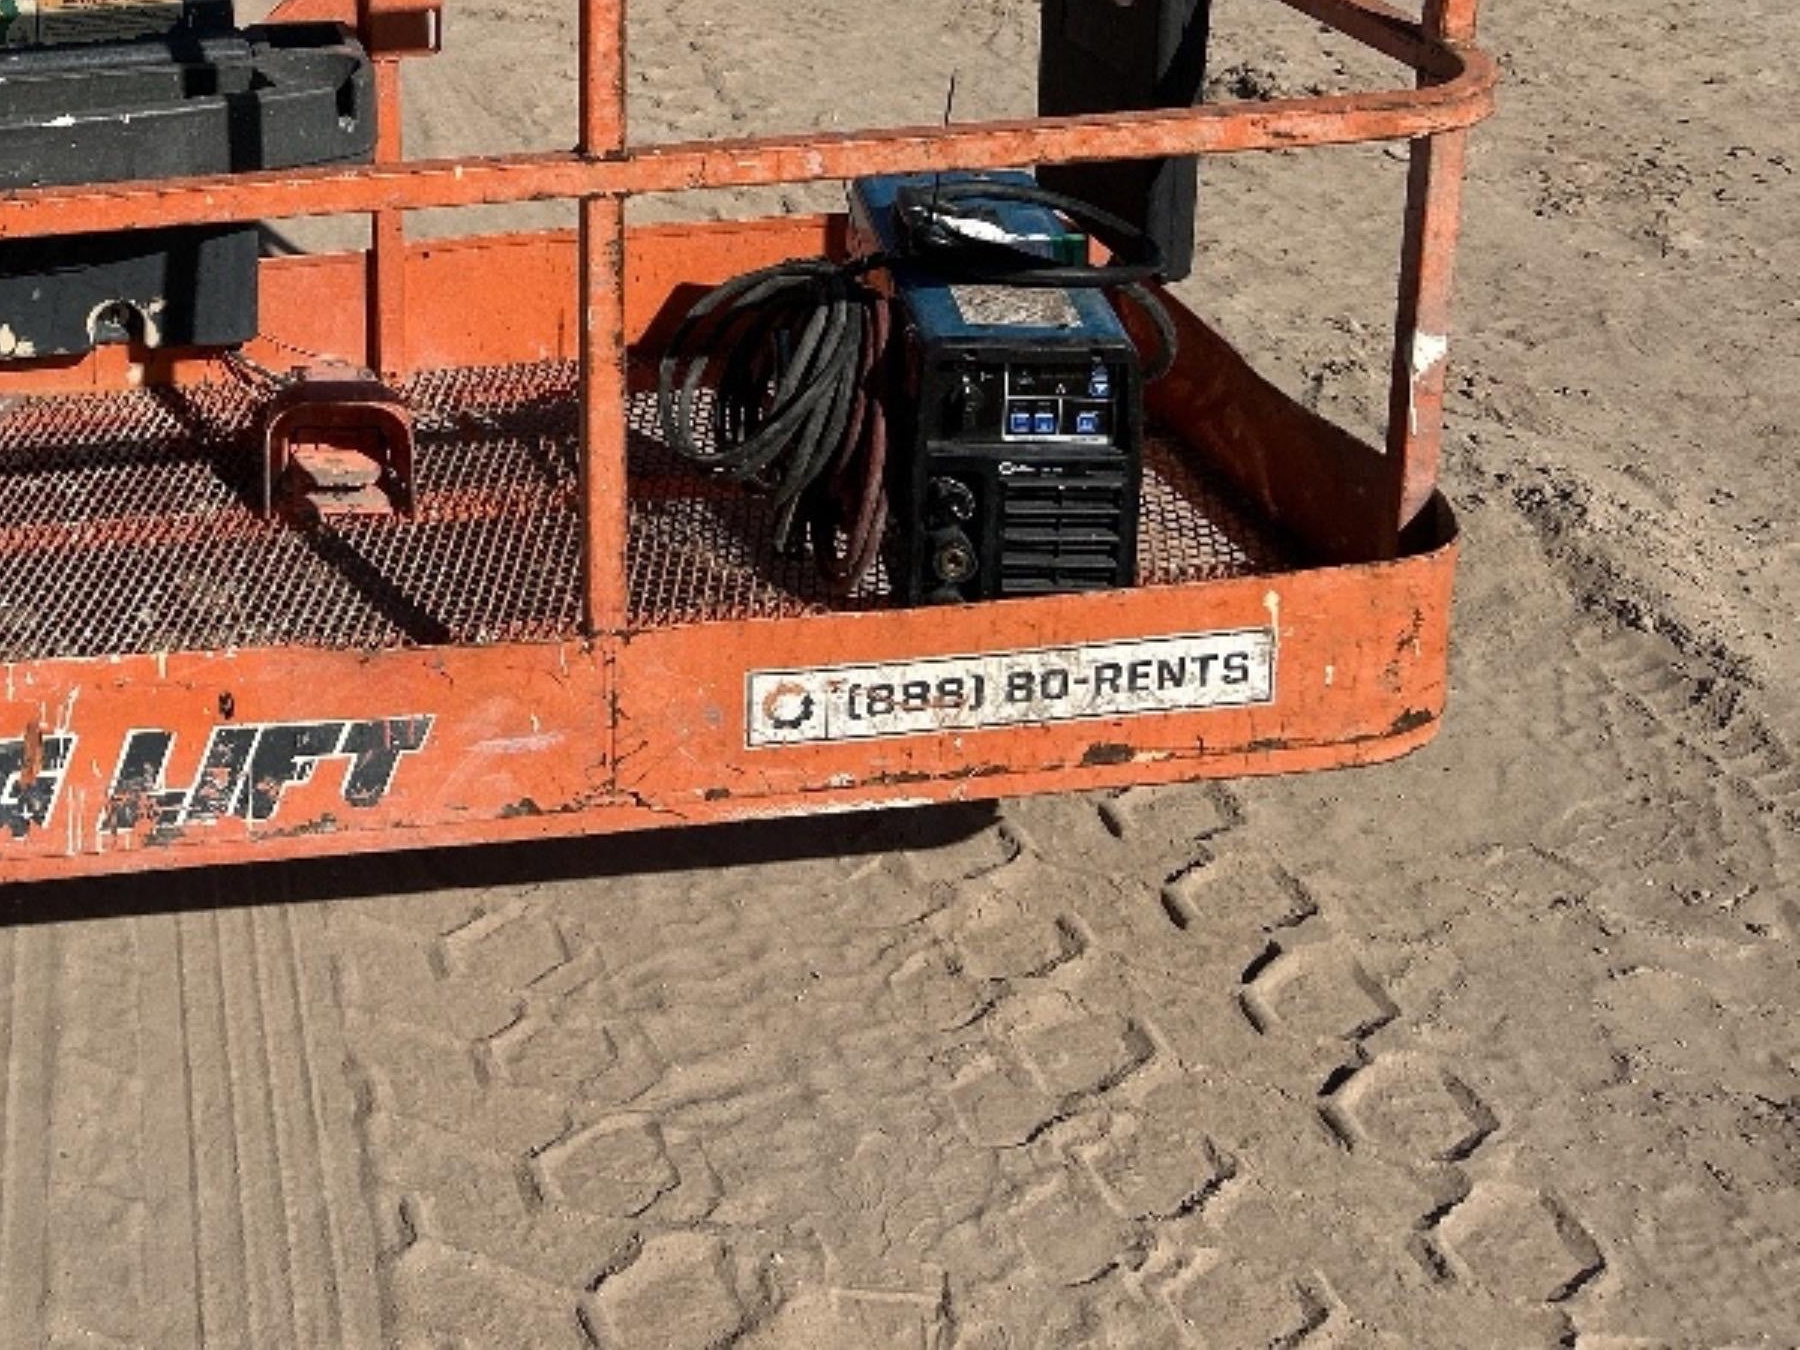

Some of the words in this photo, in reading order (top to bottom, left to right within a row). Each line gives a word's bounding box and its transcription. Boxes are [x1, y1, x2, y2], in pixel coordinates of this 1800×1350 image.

[846, 673, 986, 721] (888)
[1004, 651, 1251, 703] 80-RENTS
[97, 713, 438, 848] LIFT
